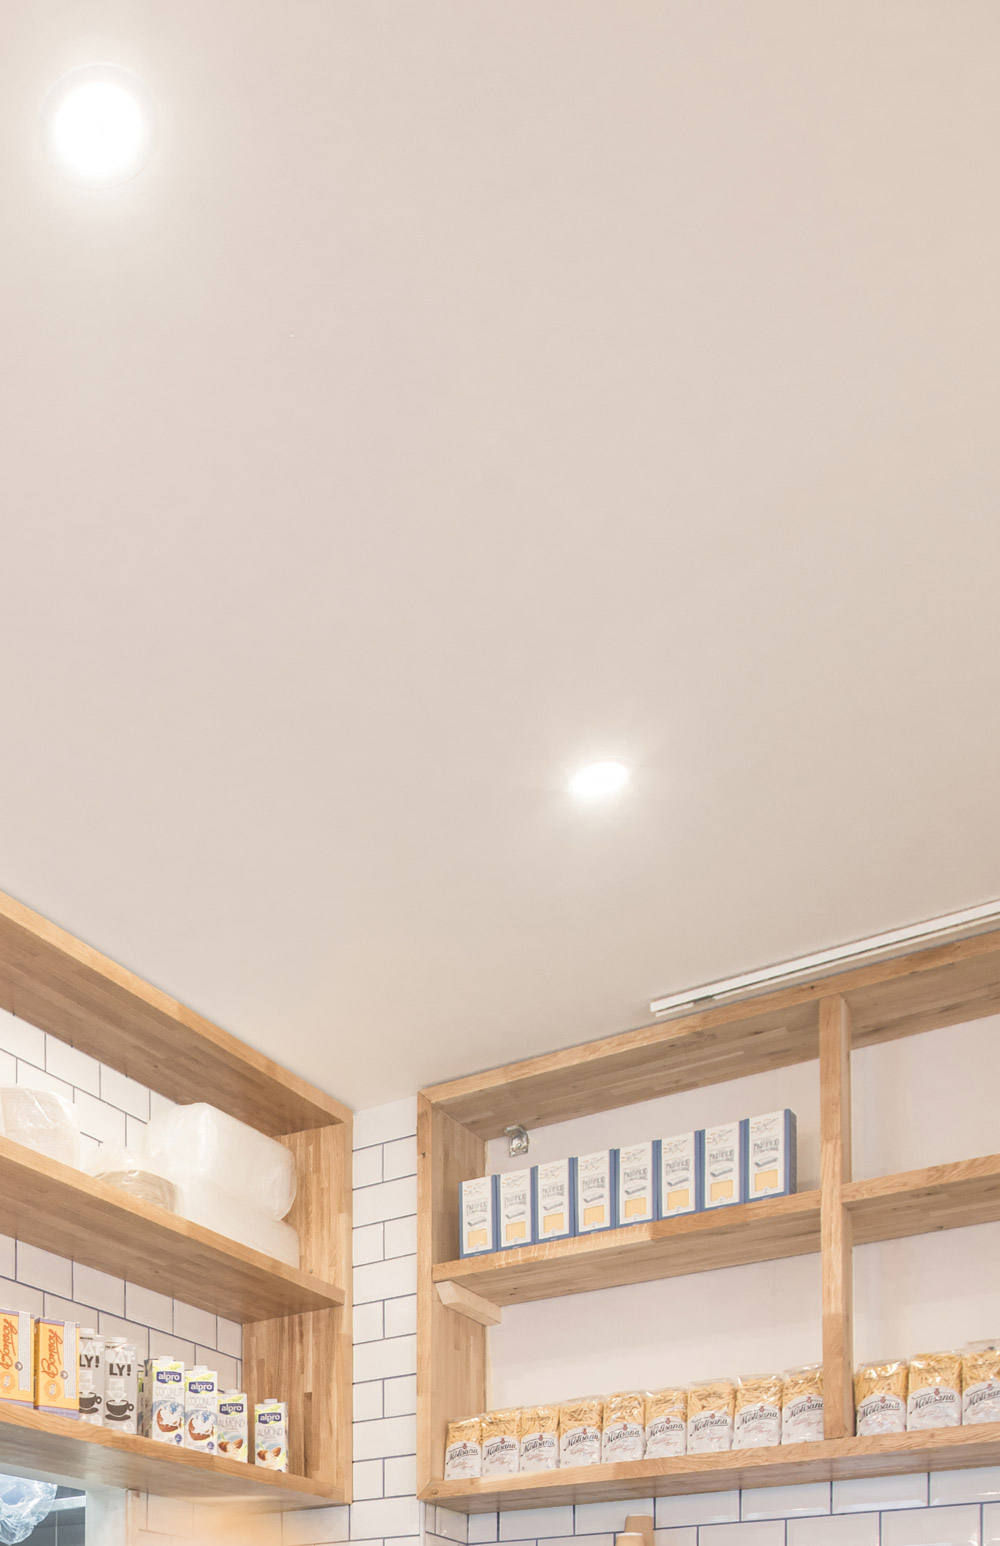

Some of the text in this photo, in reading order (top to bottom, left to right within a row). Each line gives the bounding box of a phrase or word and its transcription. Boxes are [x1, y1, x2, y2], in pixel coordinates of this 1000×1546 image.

[41, 1329, 63, 1379] Bonsoy
[79, 1354, 100, 1368] LY!
[109, 1363, 132, 1376] LY!
[158, 1372, 181, 1384] alpro
[190, 1382, 213, 1394] alpro
[220, 1404, 243, 1415] alpro
[259, 1413, 281, 1424] alpro
